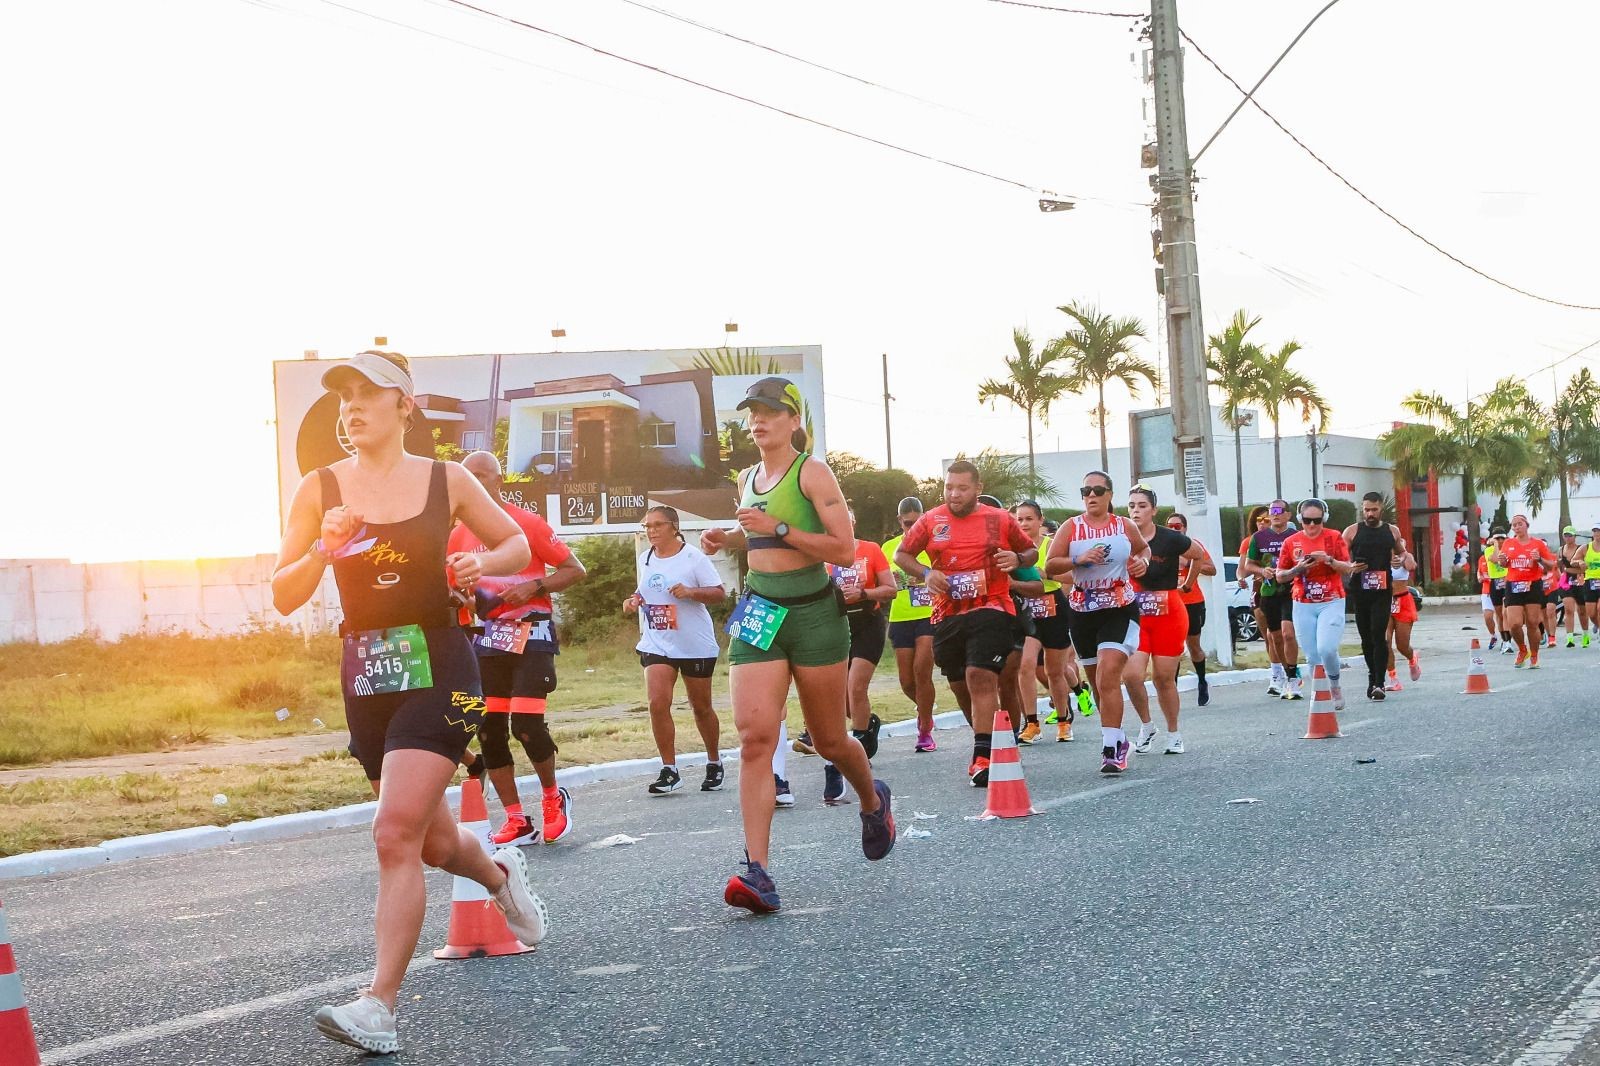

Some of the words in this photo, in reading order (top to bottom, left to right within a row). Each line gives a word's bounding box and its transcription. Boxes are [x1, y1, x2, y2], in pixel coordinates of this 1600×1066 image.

[564, 483, 587, 495] CASAS
[590, 482, 598, 494] DE
[567, 497, 577, 518] 2
[610, 496, 621, 508] 20
[622, 495, 644, 508] ITENS
[957, 583, 975, 592] 7673
[1032, 605, 1046, 613] 5797
[741, 615, 764, 633] 5365
[491, 631, 513, 643] 6376
[365, 657, 403, 677] 5415
